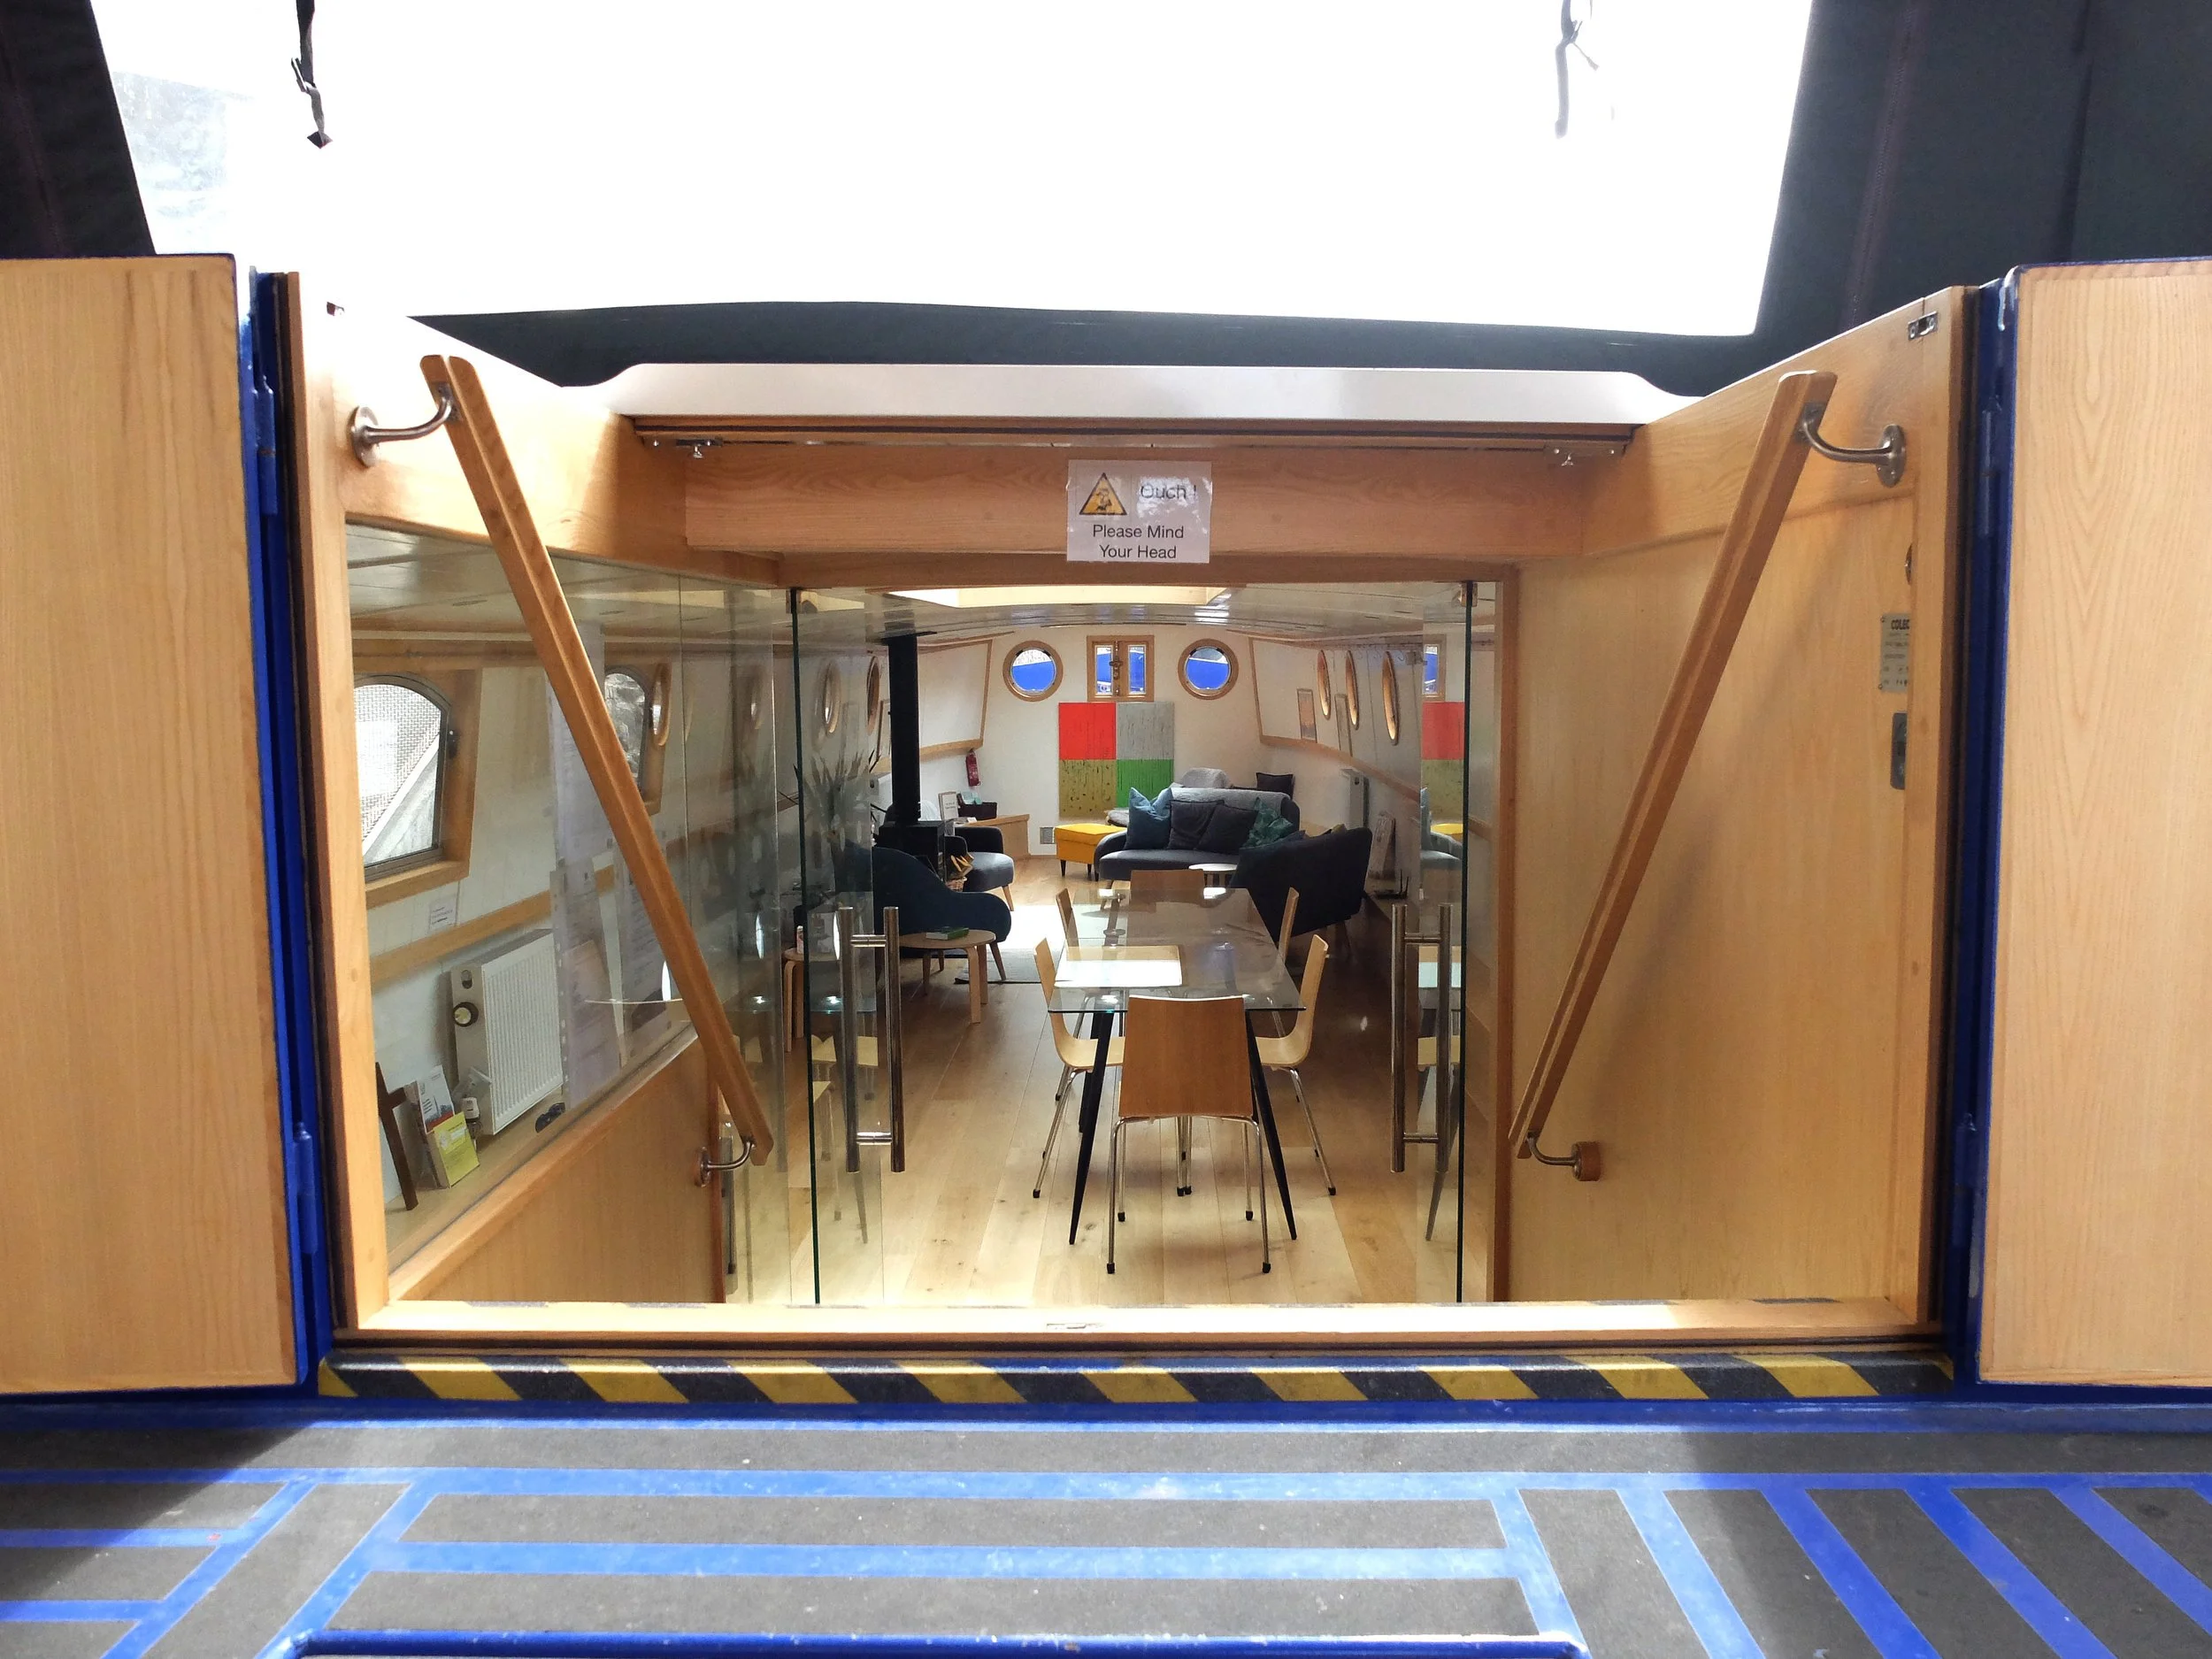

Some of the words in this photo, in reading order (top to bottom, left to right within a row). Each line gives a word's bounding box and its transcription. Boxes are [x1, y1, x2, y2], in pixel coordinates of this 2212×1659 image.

[1141, 484, 1187, 499] Ouch
[1093, 524, 1142, 538] Please
[1148, 525, 1184, 539] Mind
[1100, 544, 1133, 558] Your
[1137, 545, 1177, 558] Head
